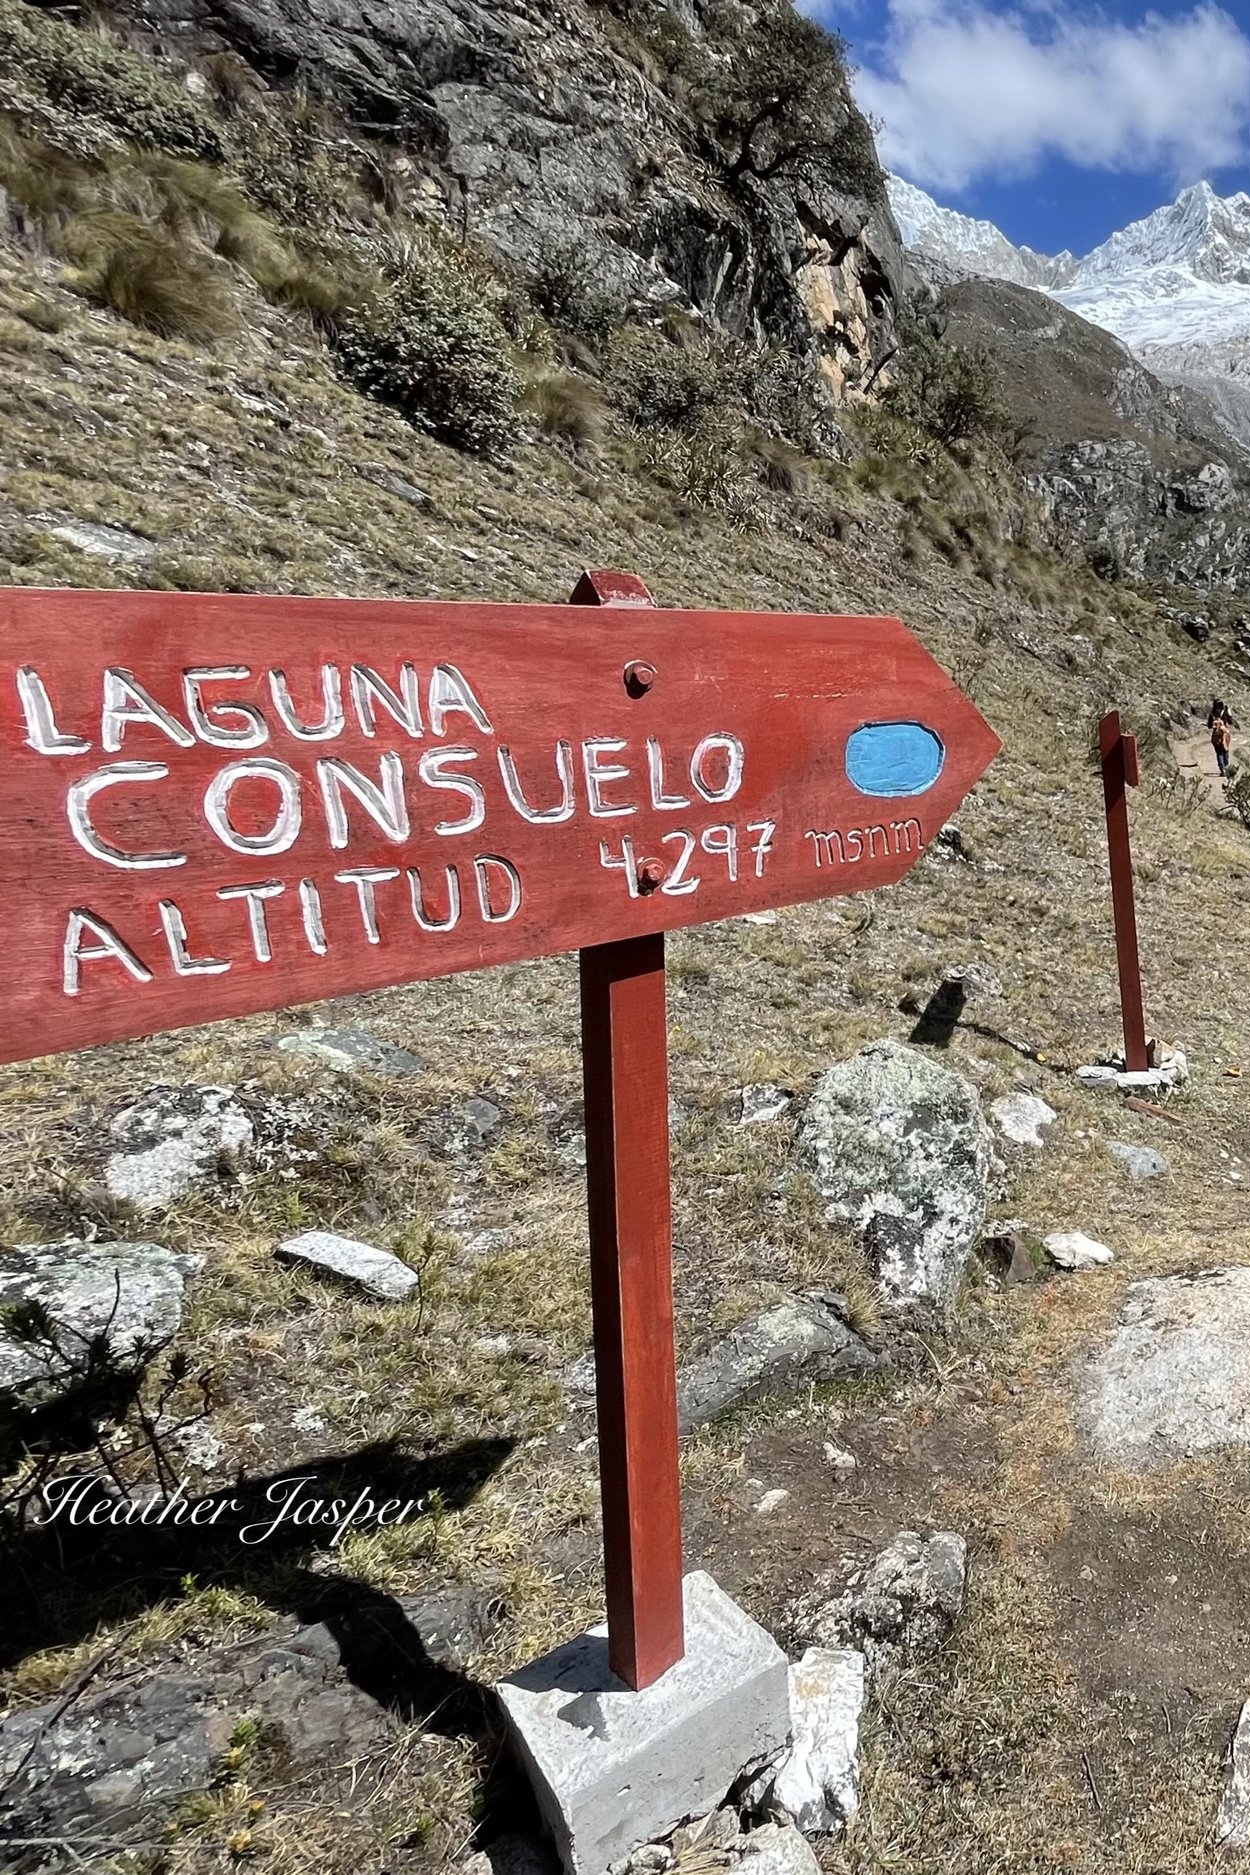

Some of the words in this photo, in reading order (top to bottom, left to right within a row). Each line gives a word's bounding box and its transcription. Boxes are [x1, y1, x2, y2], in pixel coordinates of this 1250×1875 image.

[16, 661, 494, 756] LAGUNA
[66, 730, 746, 870] CONSUELO
[62, 852, 523, 996] ALTITUD
[803, 816, 925, 868] msnm
